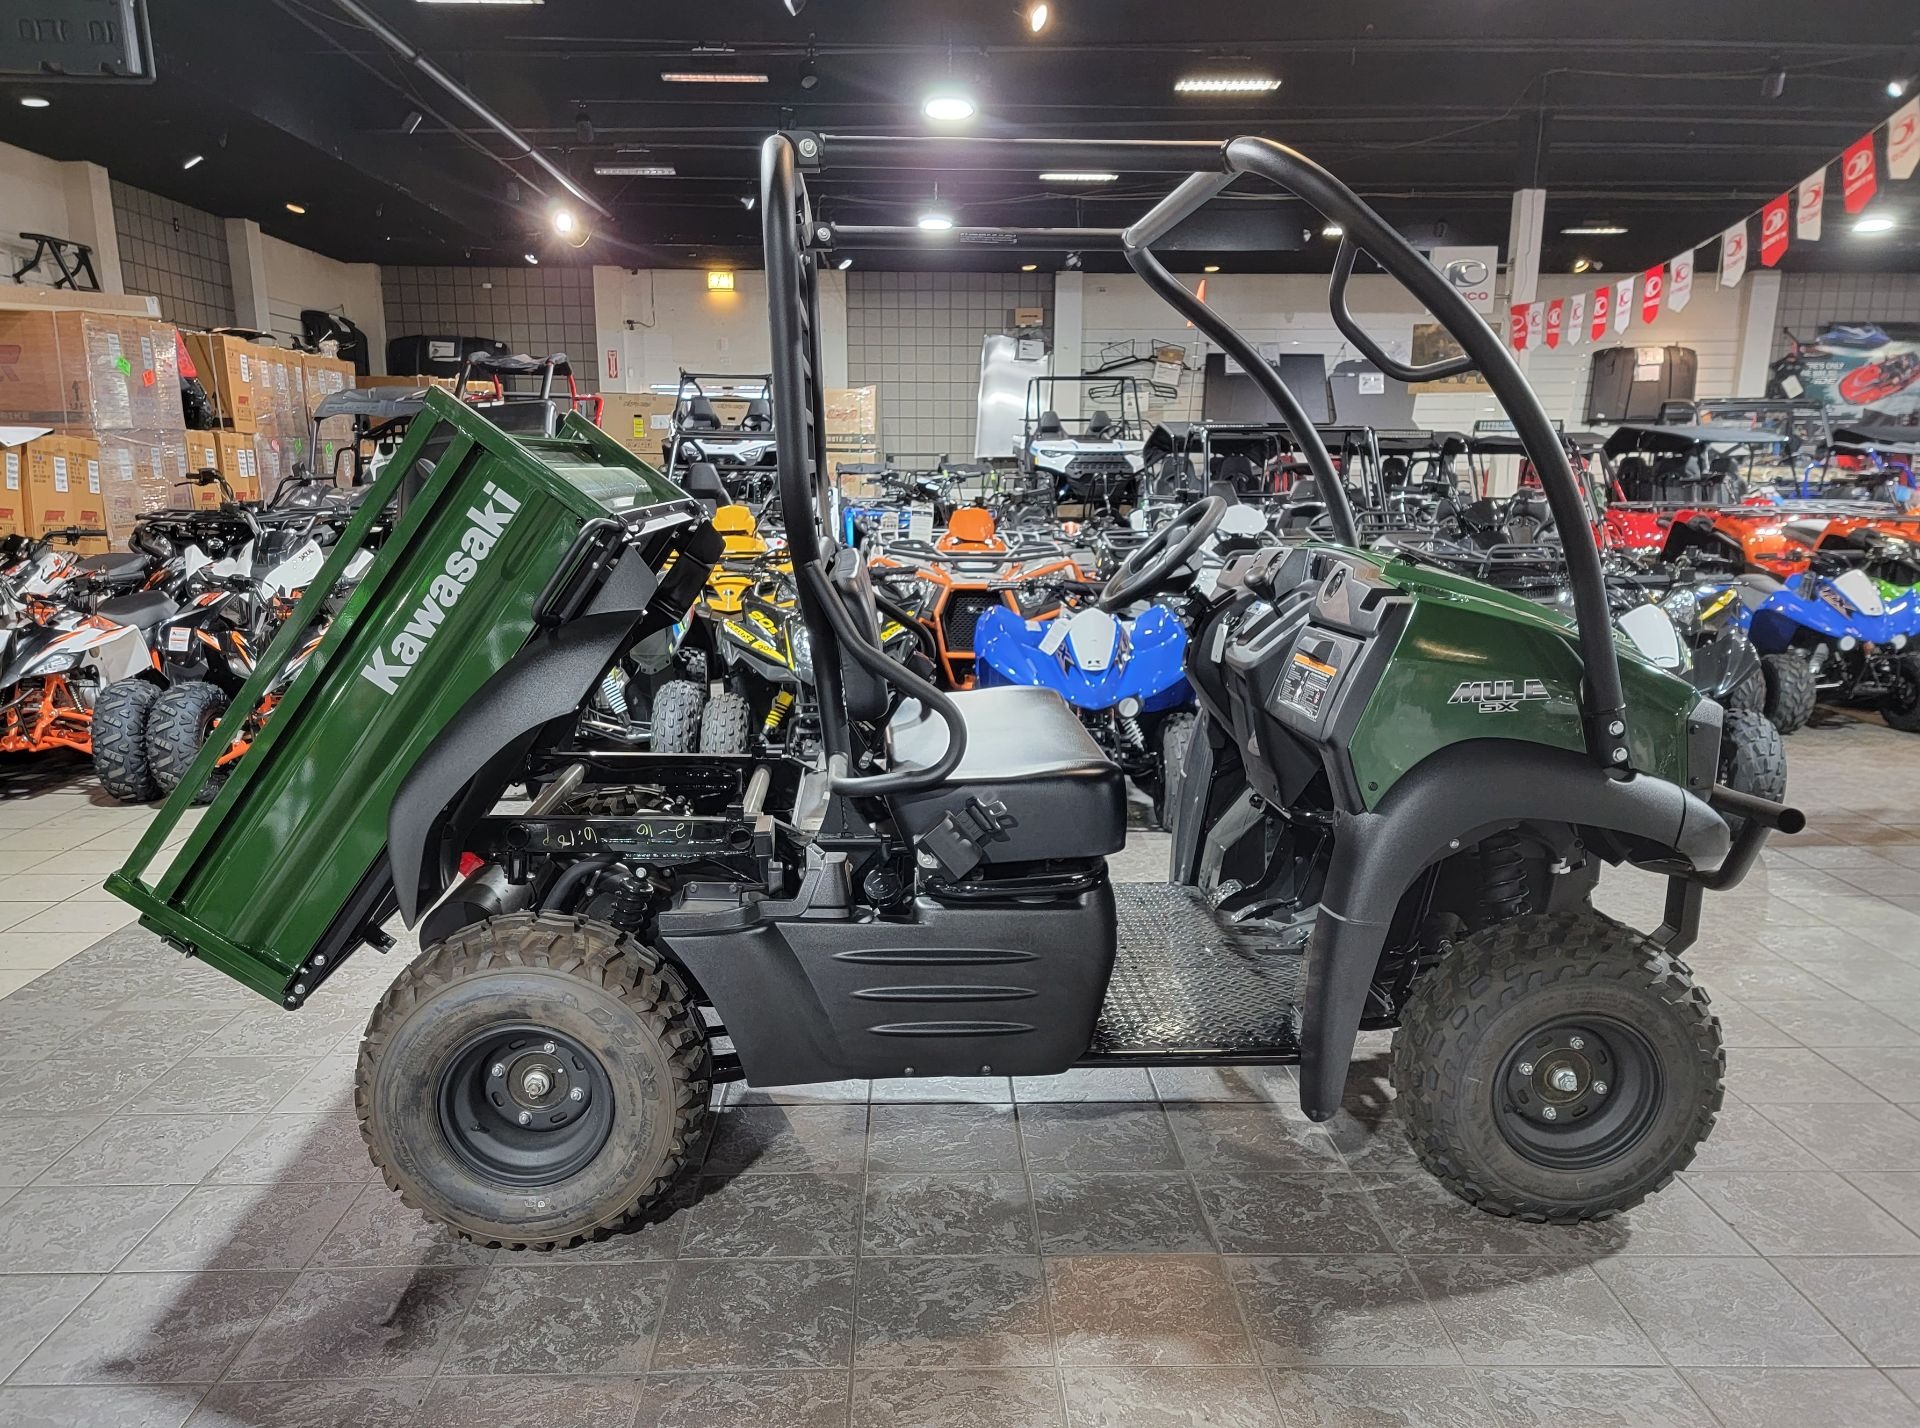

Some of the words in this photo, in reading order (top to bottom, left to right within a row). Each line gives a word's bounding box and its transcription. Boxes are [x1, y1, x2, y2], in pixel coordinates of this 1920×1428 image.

[360, 480, 522, 696] Kawasaki
[1447, 678, 1552, 704] MULE
[1479, 700, 1520, 713] SX
